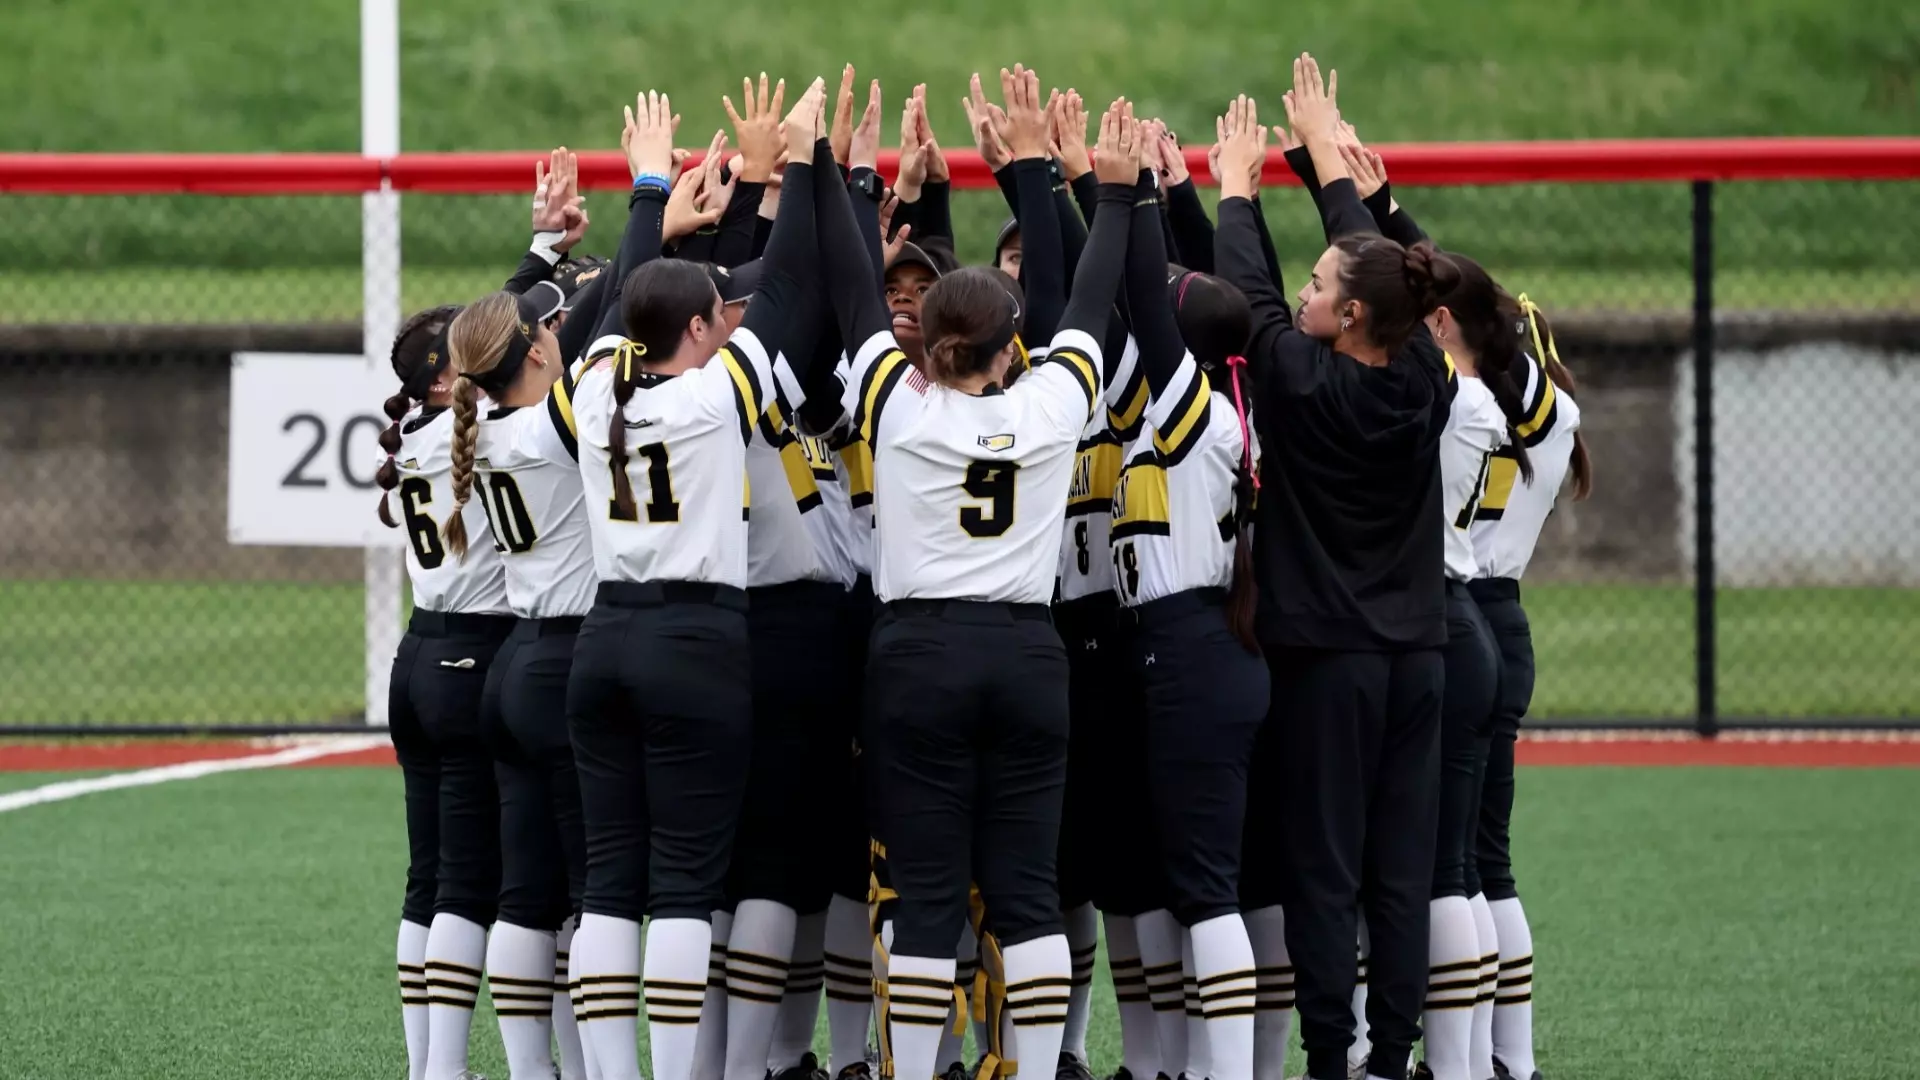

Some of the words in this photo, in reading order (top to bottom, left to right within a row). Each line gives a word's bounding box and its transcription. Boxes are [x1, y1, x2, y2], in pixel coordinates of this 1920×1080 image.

[400, 475, 446, 570] 6
[473, 470, 538, 553] 10
[603, 441, 680, 523] 11
[958, 459, 1021, 539] 9
[1113, 542, 1140, 603] 18
